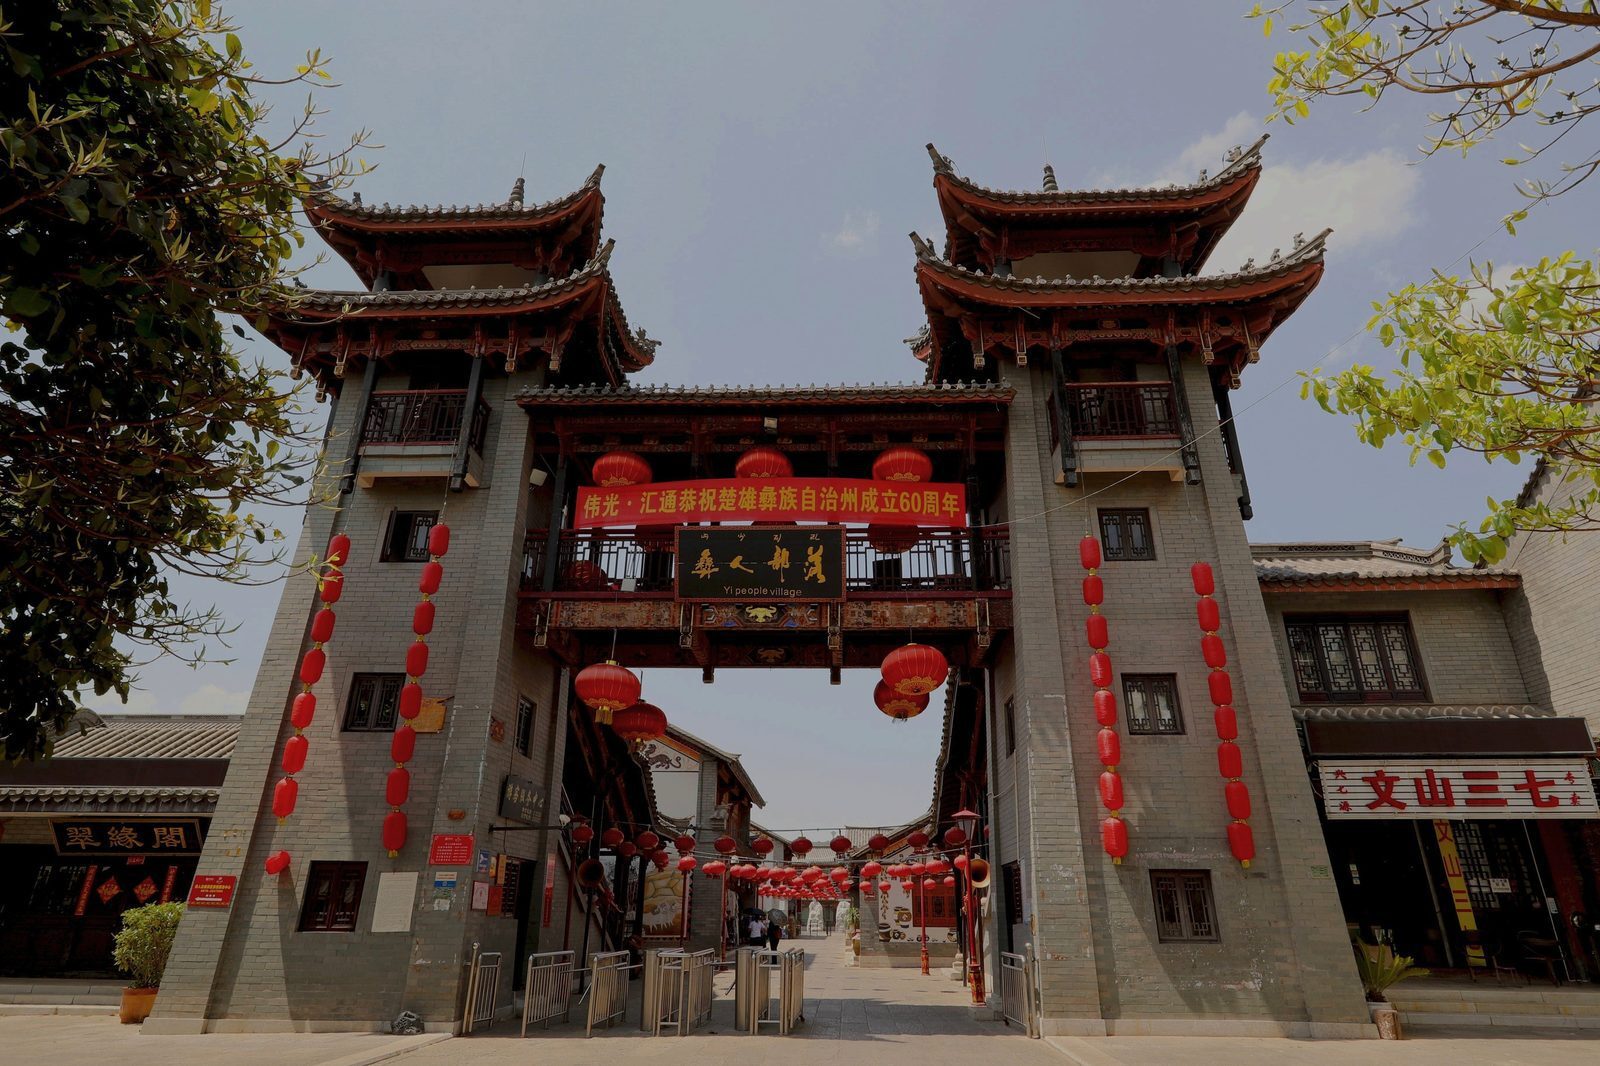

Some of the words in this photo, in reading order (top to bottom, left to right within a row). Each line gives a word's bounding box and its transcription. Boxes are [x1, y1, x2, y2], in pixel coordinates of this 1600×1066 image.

[583, 485, 960, 519] 伟光·汇通恭祝楚雄彝族自治州成立60周年
[691, 544, 827, 584] 彝人部落
[723, 586, 733, 595] Yi
[735, 586, 768, 597] people
[769, 587, 803, 598] village
[1361, 769, 1560, 810] 文山三七
